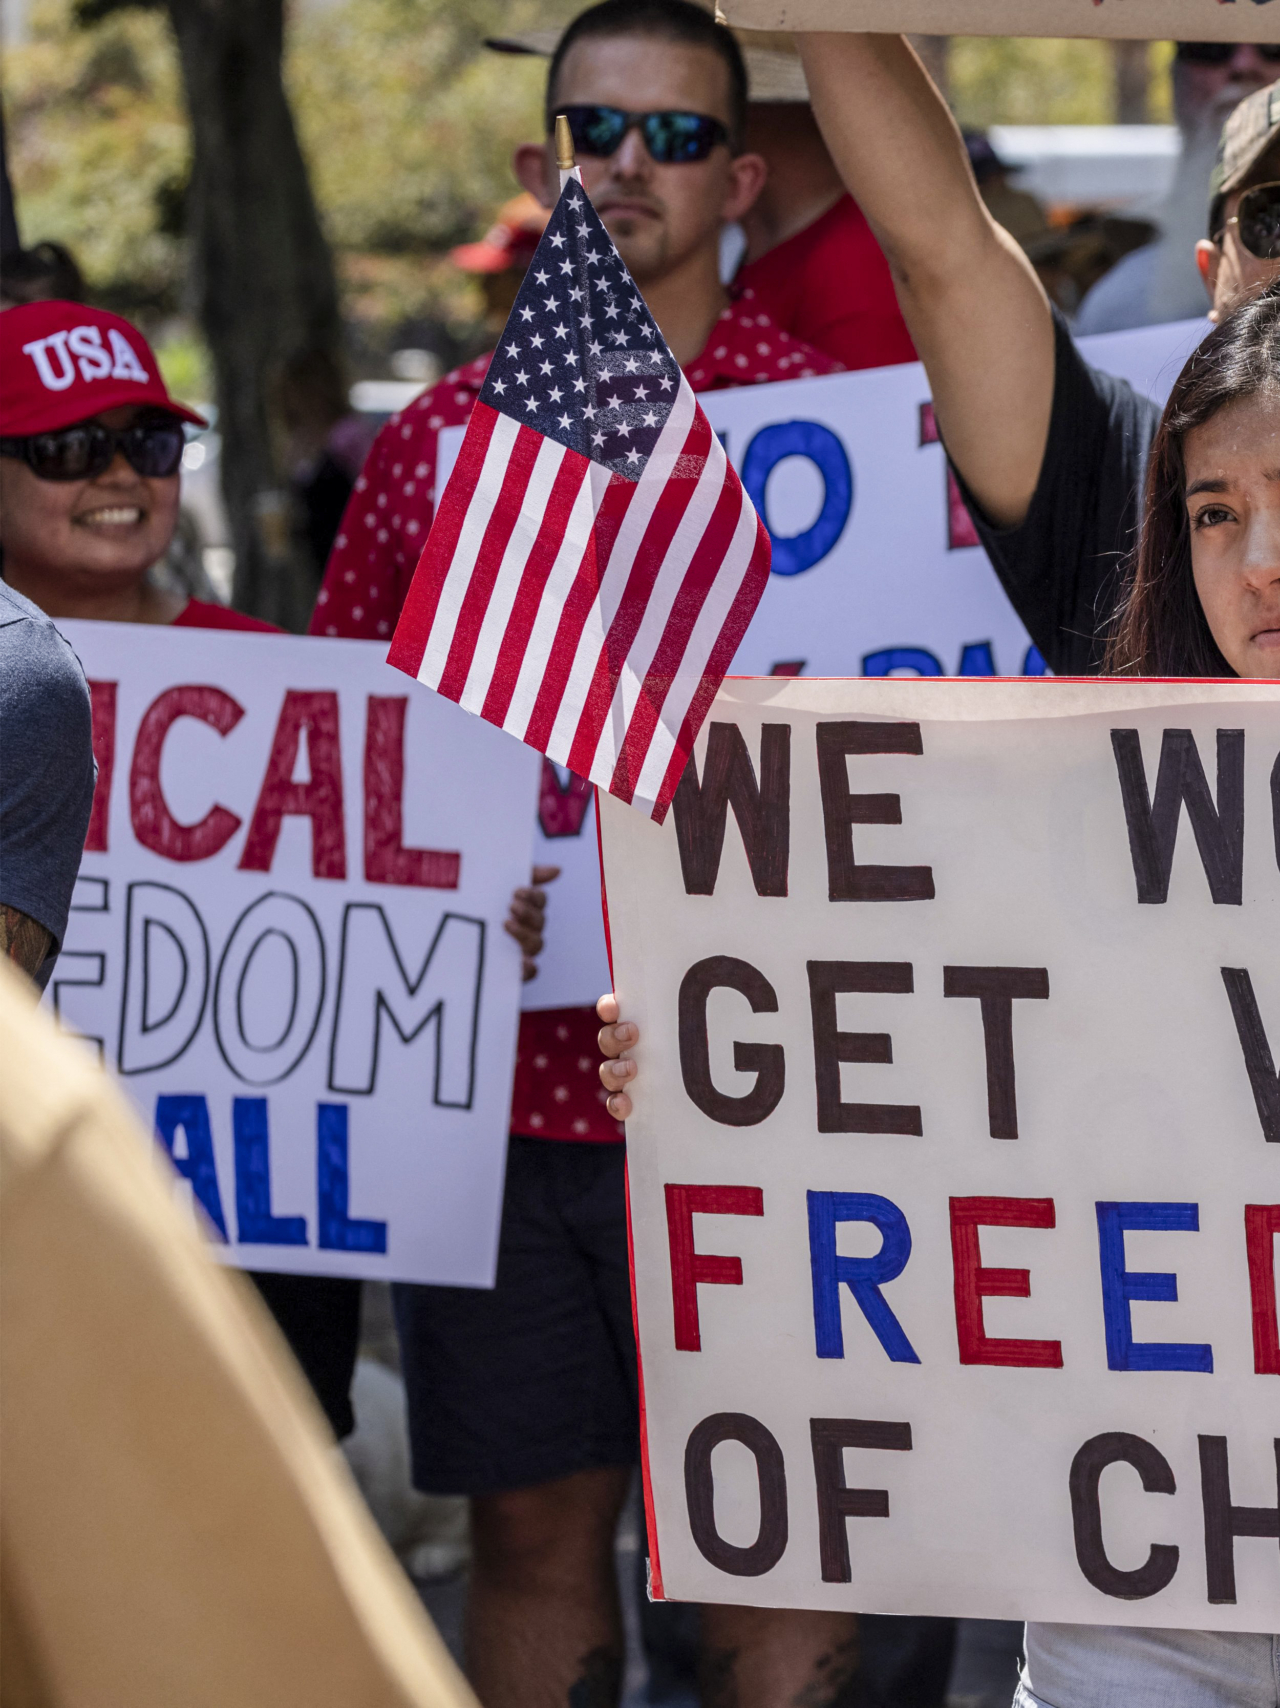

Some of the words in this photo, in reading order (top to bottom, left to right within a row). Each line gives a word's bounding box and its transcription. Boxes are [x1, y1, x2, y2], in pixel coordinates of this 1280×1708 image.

[22, 325, 150, 392] USA
[672, 721, 936, 902] WE
[678, 955, 1050, 1140] GET
[155, 1092, 388, 1255] ALL
[684, 1412, 913, 1584] OF
